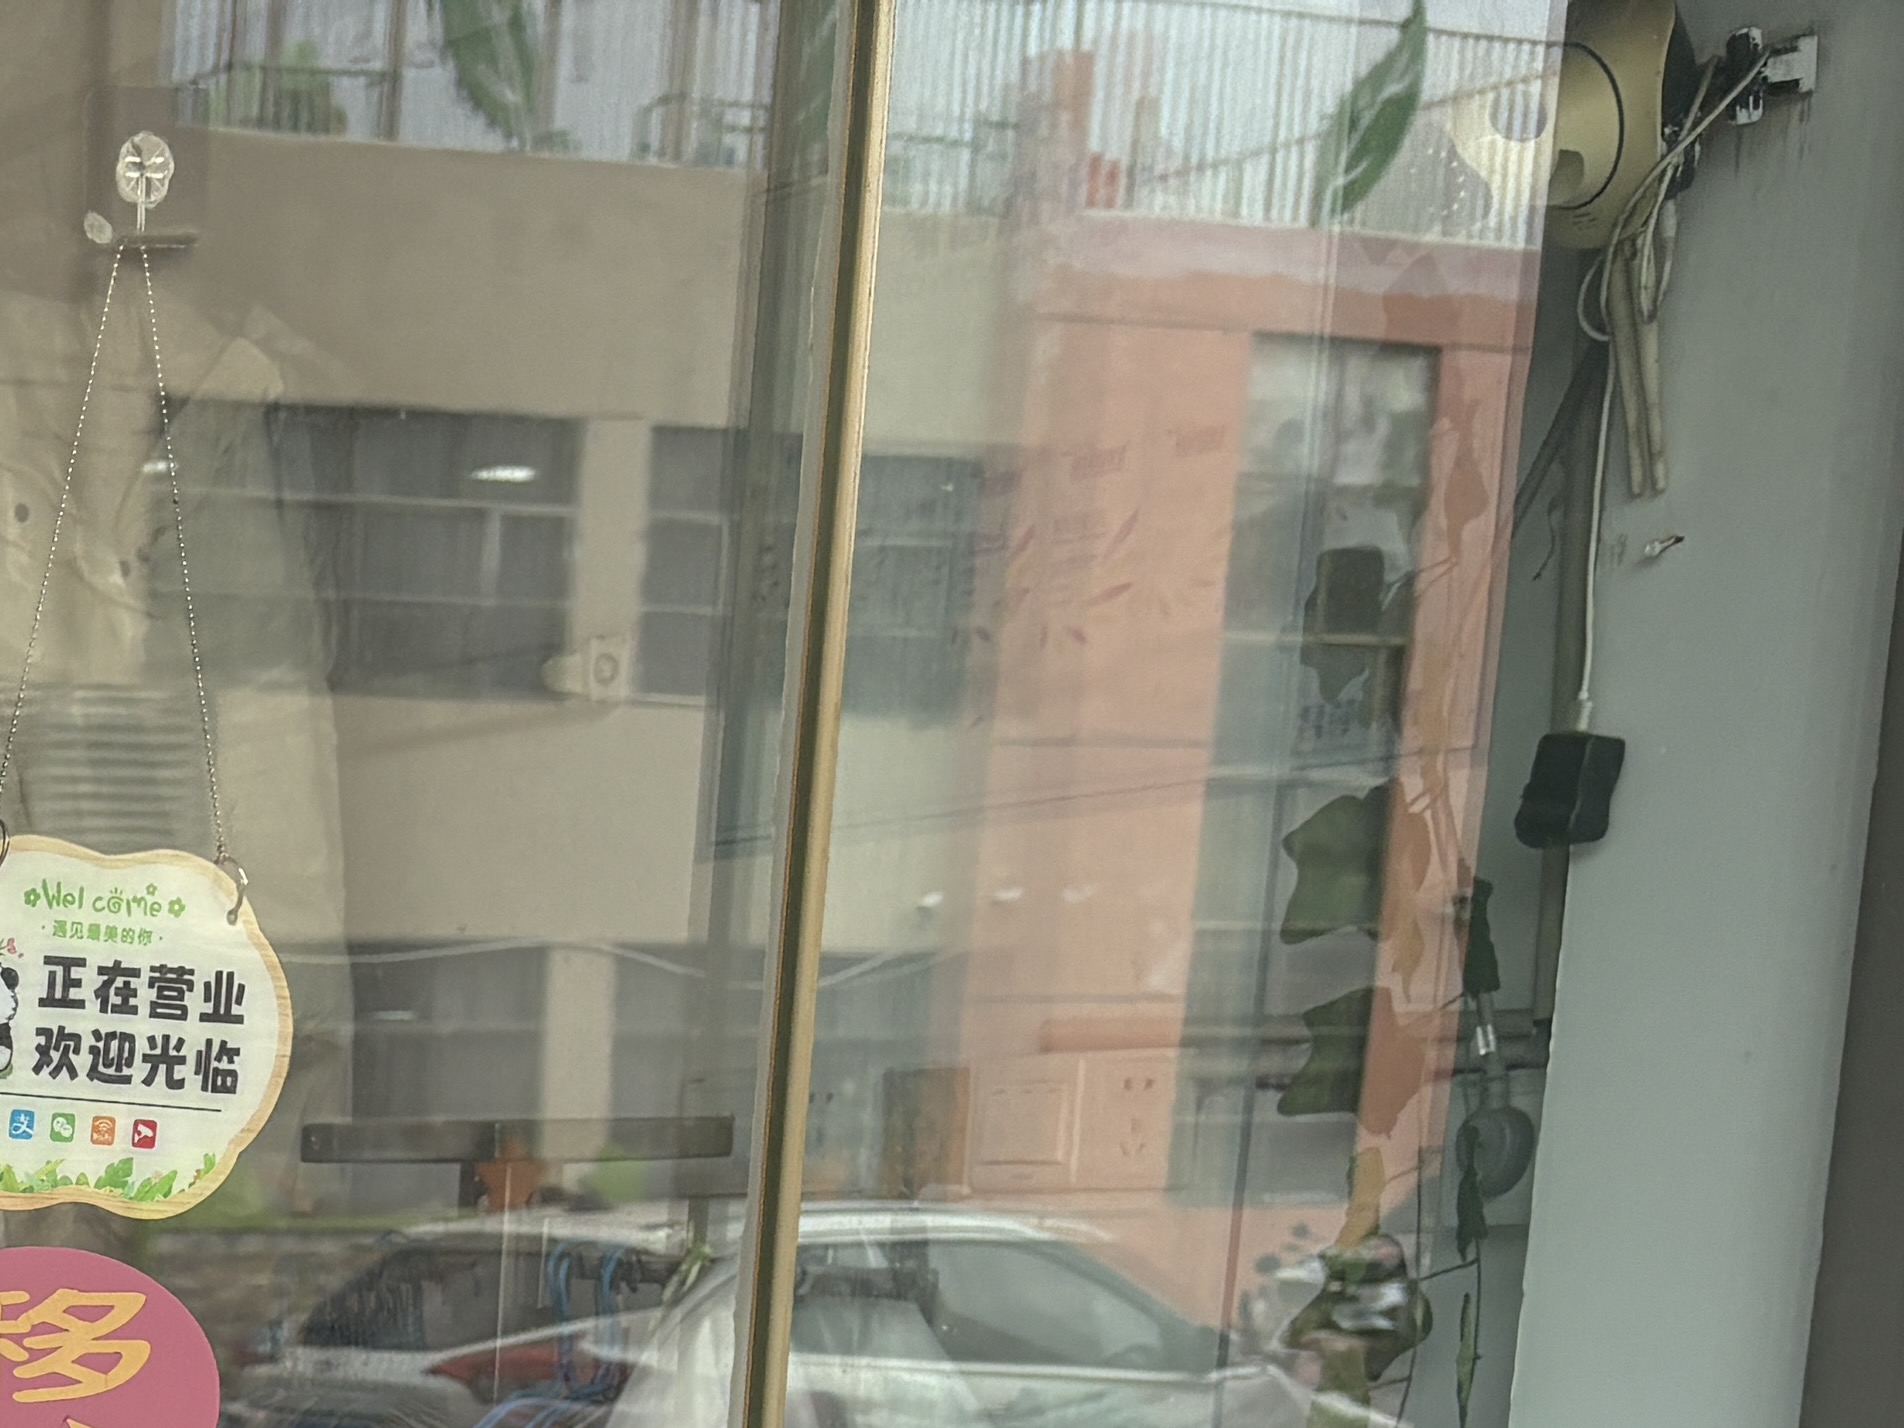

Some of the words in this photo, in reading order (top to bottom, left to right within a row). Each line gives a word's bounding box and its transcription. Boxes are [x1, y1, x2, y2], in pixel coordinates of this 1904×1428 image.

[37, 955, 247, 1025] 正在营业
[31, 1024, 242, 1095] 欢迎光临
